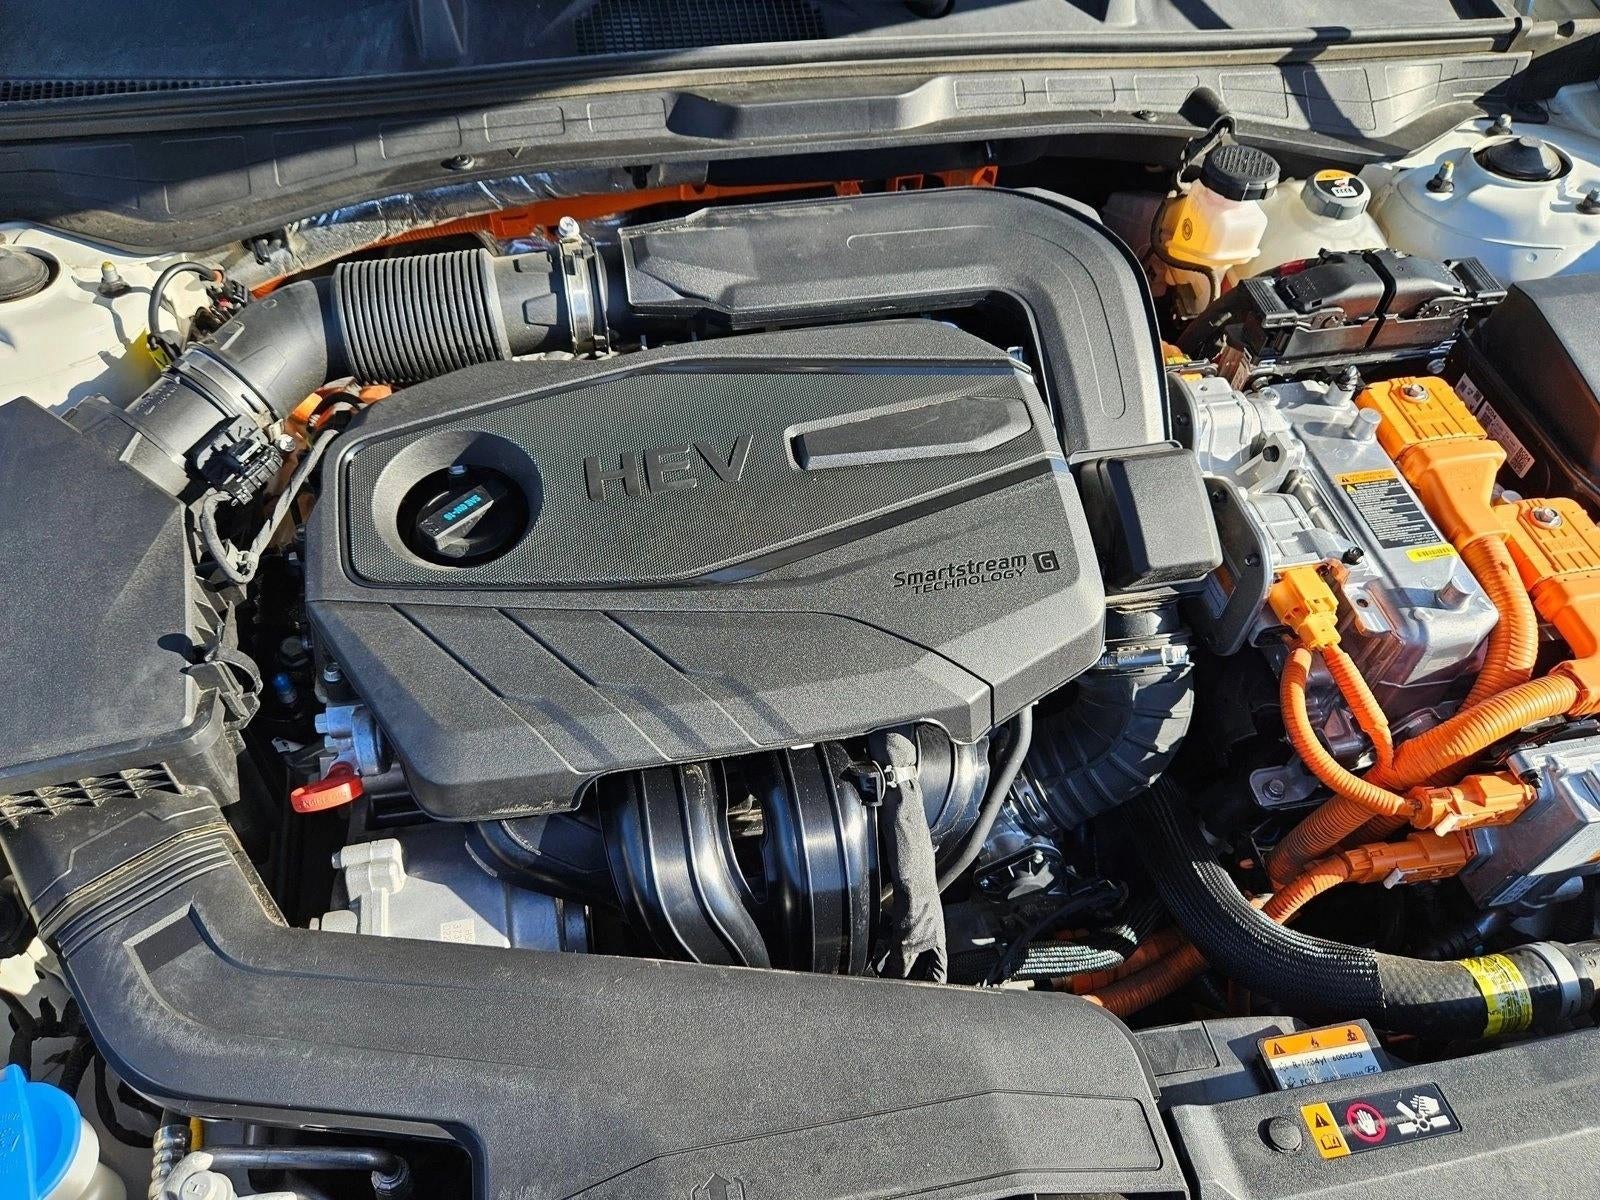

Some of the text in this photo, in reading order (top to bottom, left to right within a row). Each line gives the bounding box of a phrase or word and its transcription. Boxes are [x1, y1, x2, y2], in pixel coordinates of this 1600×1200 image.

[584, 434, 754, 502] HEV
[466, 494, 482, 507] SAE
[893, 554, 1027, 588] Smartstream
[912, 568, 1026, 594] TECHNOLOGY
